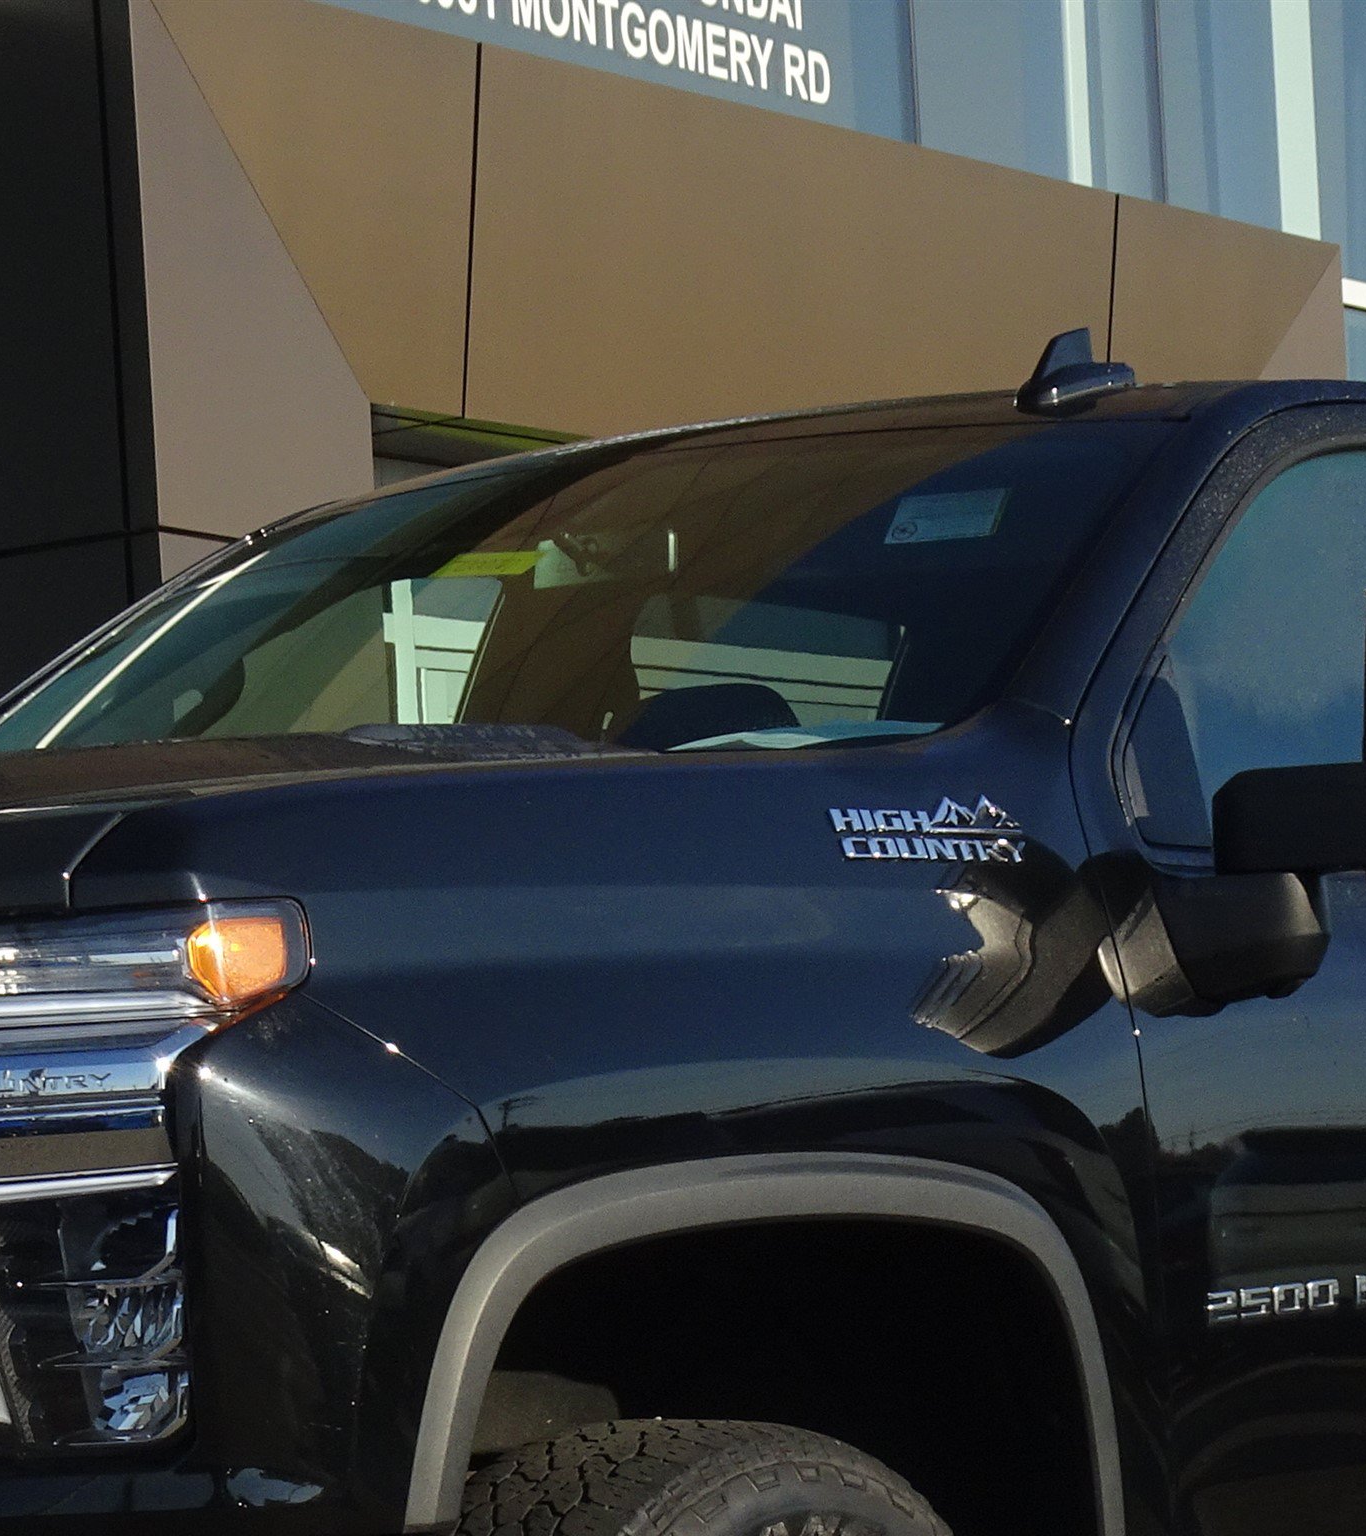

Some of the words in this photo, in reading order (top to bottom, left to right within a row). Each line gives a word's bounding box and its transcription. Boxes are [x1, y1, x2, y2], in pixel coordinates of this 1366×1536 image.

[511, 0, 774, 90] MONTGOMERY
[784, 43, 831, 104] RD
[829, 808, 934, 832] HIGH
[840, 836, 1026, 863] COUNTRY
[1206, 1278, 1340, 1322] 2500
